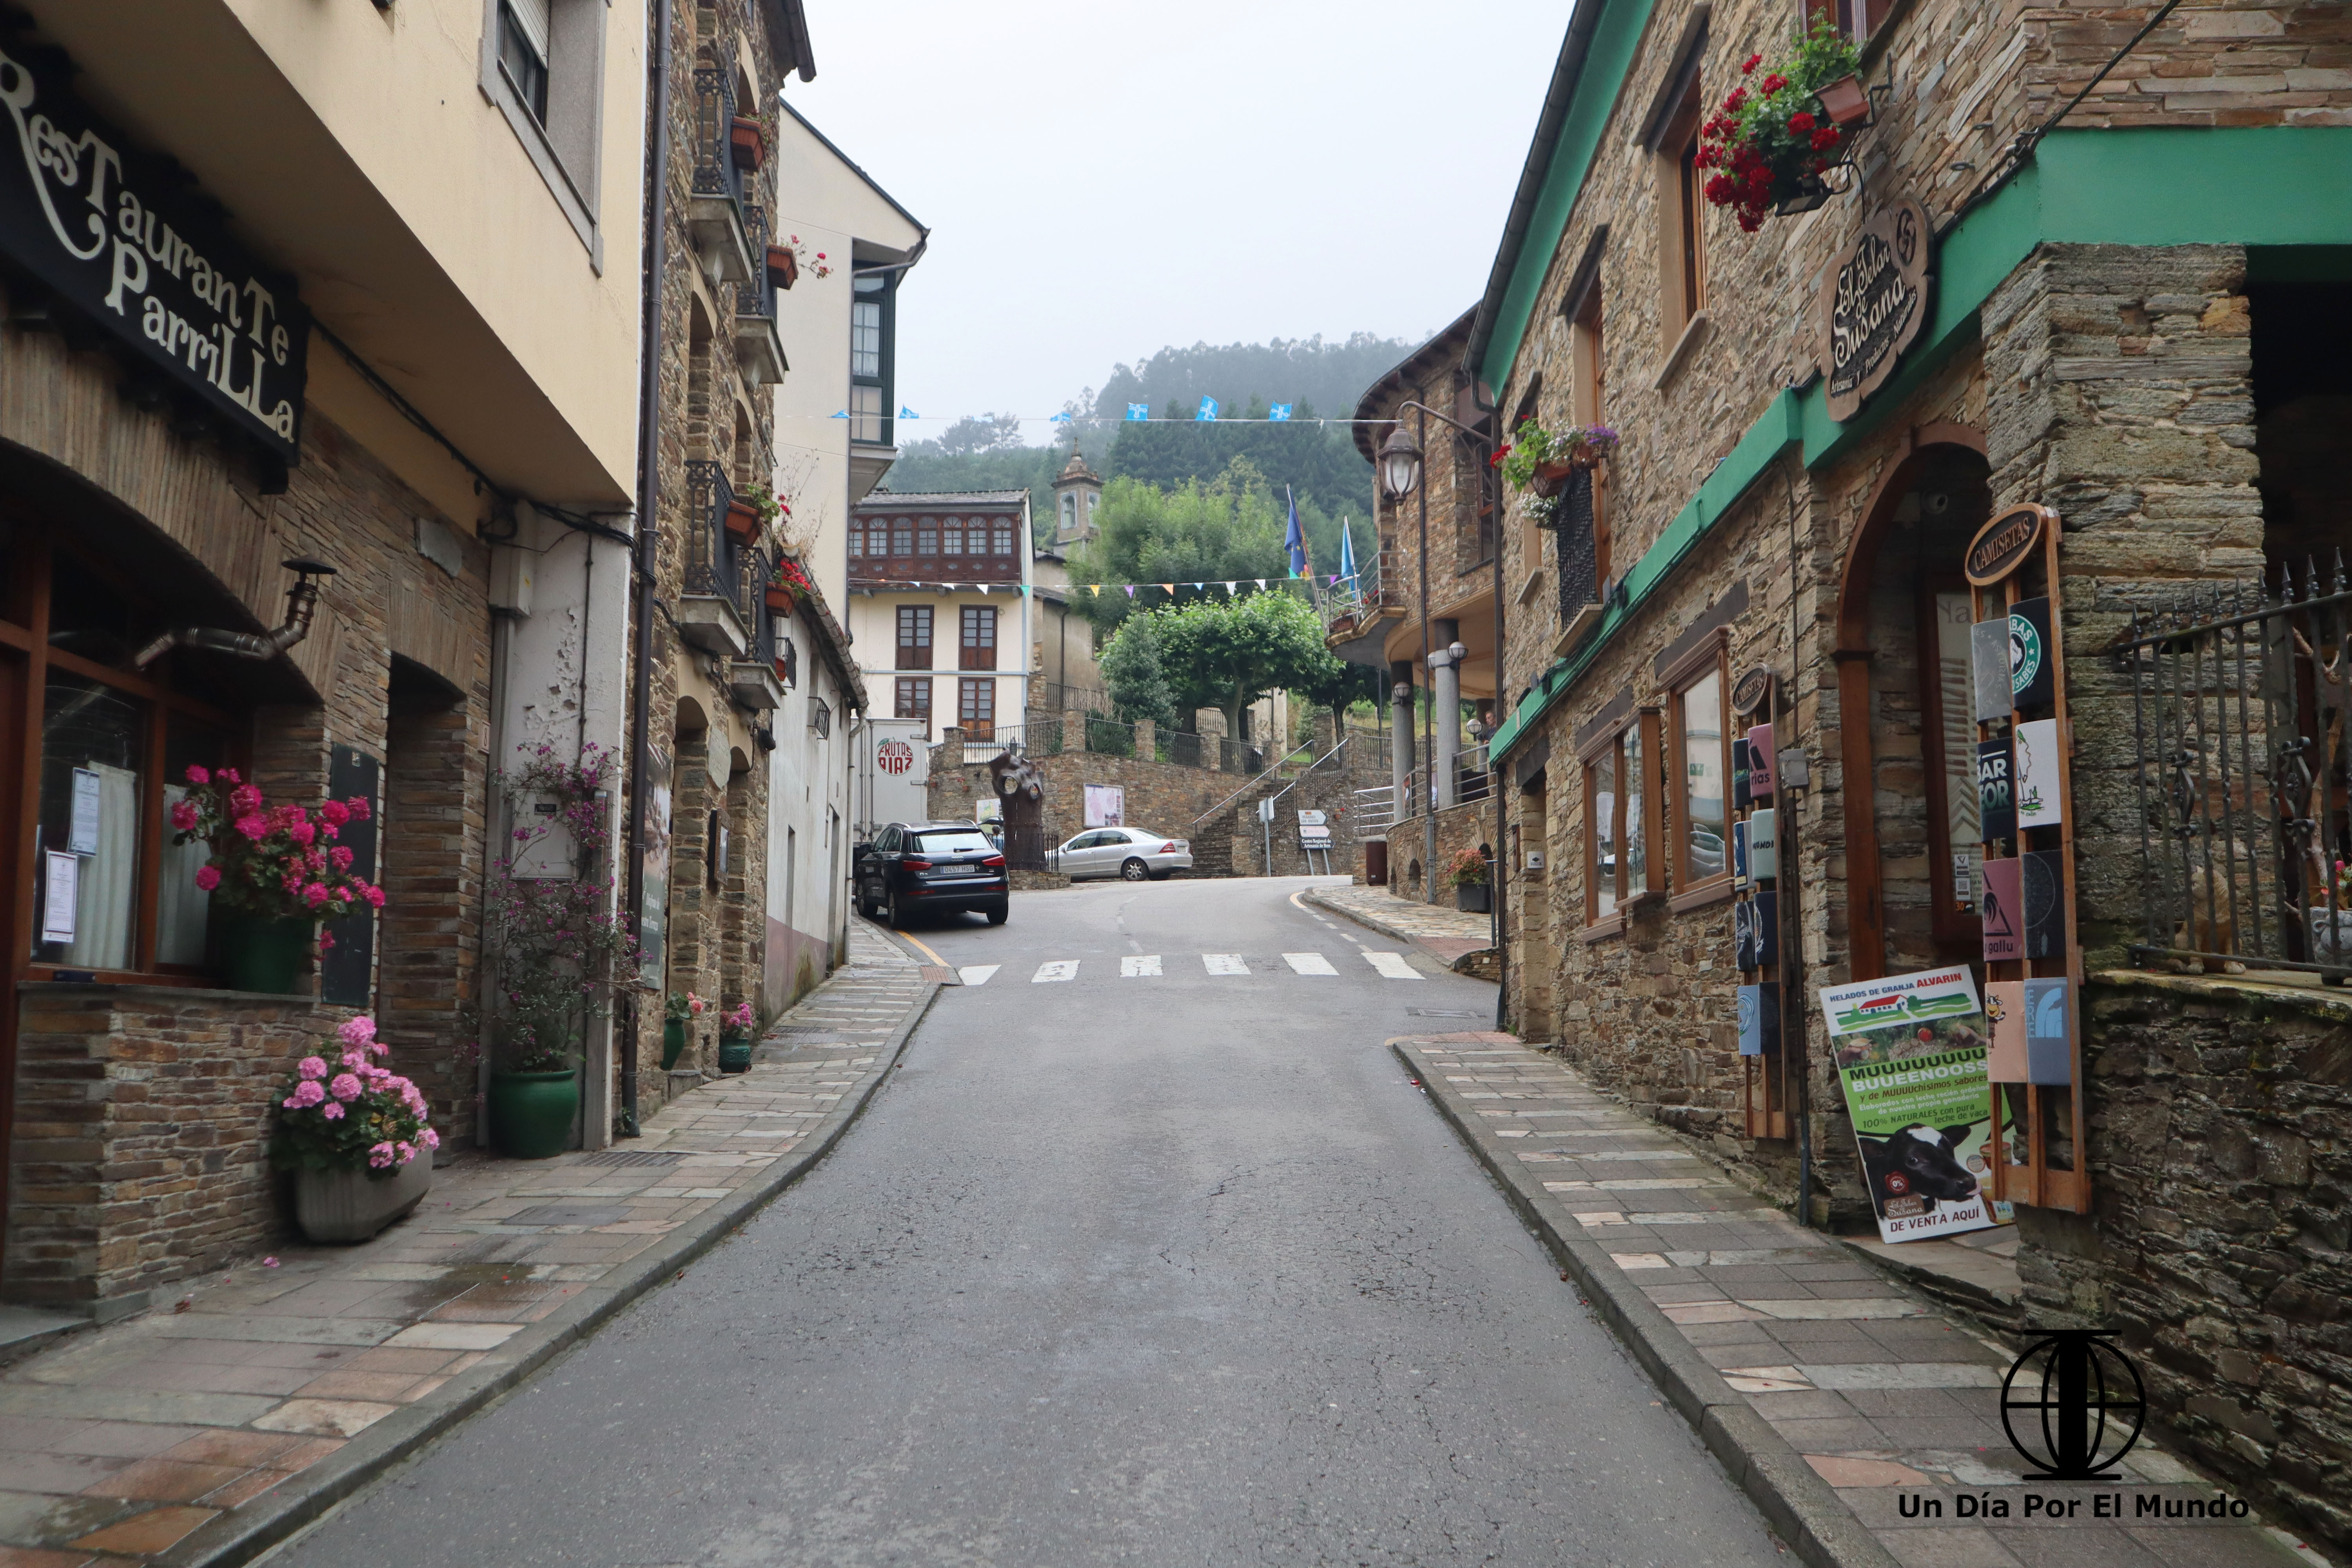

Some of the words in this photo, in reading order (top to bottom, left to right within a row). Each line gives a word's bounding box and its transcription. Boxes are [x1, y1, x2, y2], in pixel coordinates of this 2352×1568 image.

[1838, 266, 1857, 316] El
[1857, 236, 1890, 295] Telar
[1856, 289, 1868, 320] de
[1834, 273, 1906, 368] Susana
[1866, 336, 1889, 374] Productos
[1893, 289, 1916, 339] Naturales
[1975, 516, 2030, 571] CAMISETAS
[2015, 659, 2036, 688] SABES
[1737, 672, 1763, 706] CAMISETAS
[878, 742, 912, 756] FRUTAS
[878, 757, 912, 774] DIAZ
[1989, 940, 2013, 954] gallu
[1829, 991, 1867, 1002] HELADOS
[1882, 983, 1915, 994] GRANJA
[1917, 973, 1962, 988] ALVARIN
[1859, 1100, 1900, 1111] Elaborados
[1937, 1089, 1958, 1098] recién
[1960, 1083, 1990, 1094] ordeñad
[1860, 1094, 1865, 1103] y
[1954, 1075, 1988, 1086] sabores
[1863, 1118, 1887, 1129] 100%
[1891, 1109, 1938, 1123] NATURALES
[1956, 1103, 1975, 1113] pura
[1889, 1103, 1916, 1113] nuestra
[1918, 1100, 1941, 1109] propia
[1935, 1114, 1955, 1123] leche
[1970, 1109, 1988, 1118] vaca
[1892, 1180, 1904, 1188] 0%
[1888, 1206, 1923, 1217] Susana
[1890, 1221, 1905, 1232] DE
[1952, 1205, 1980, 1222] AQUÍ
